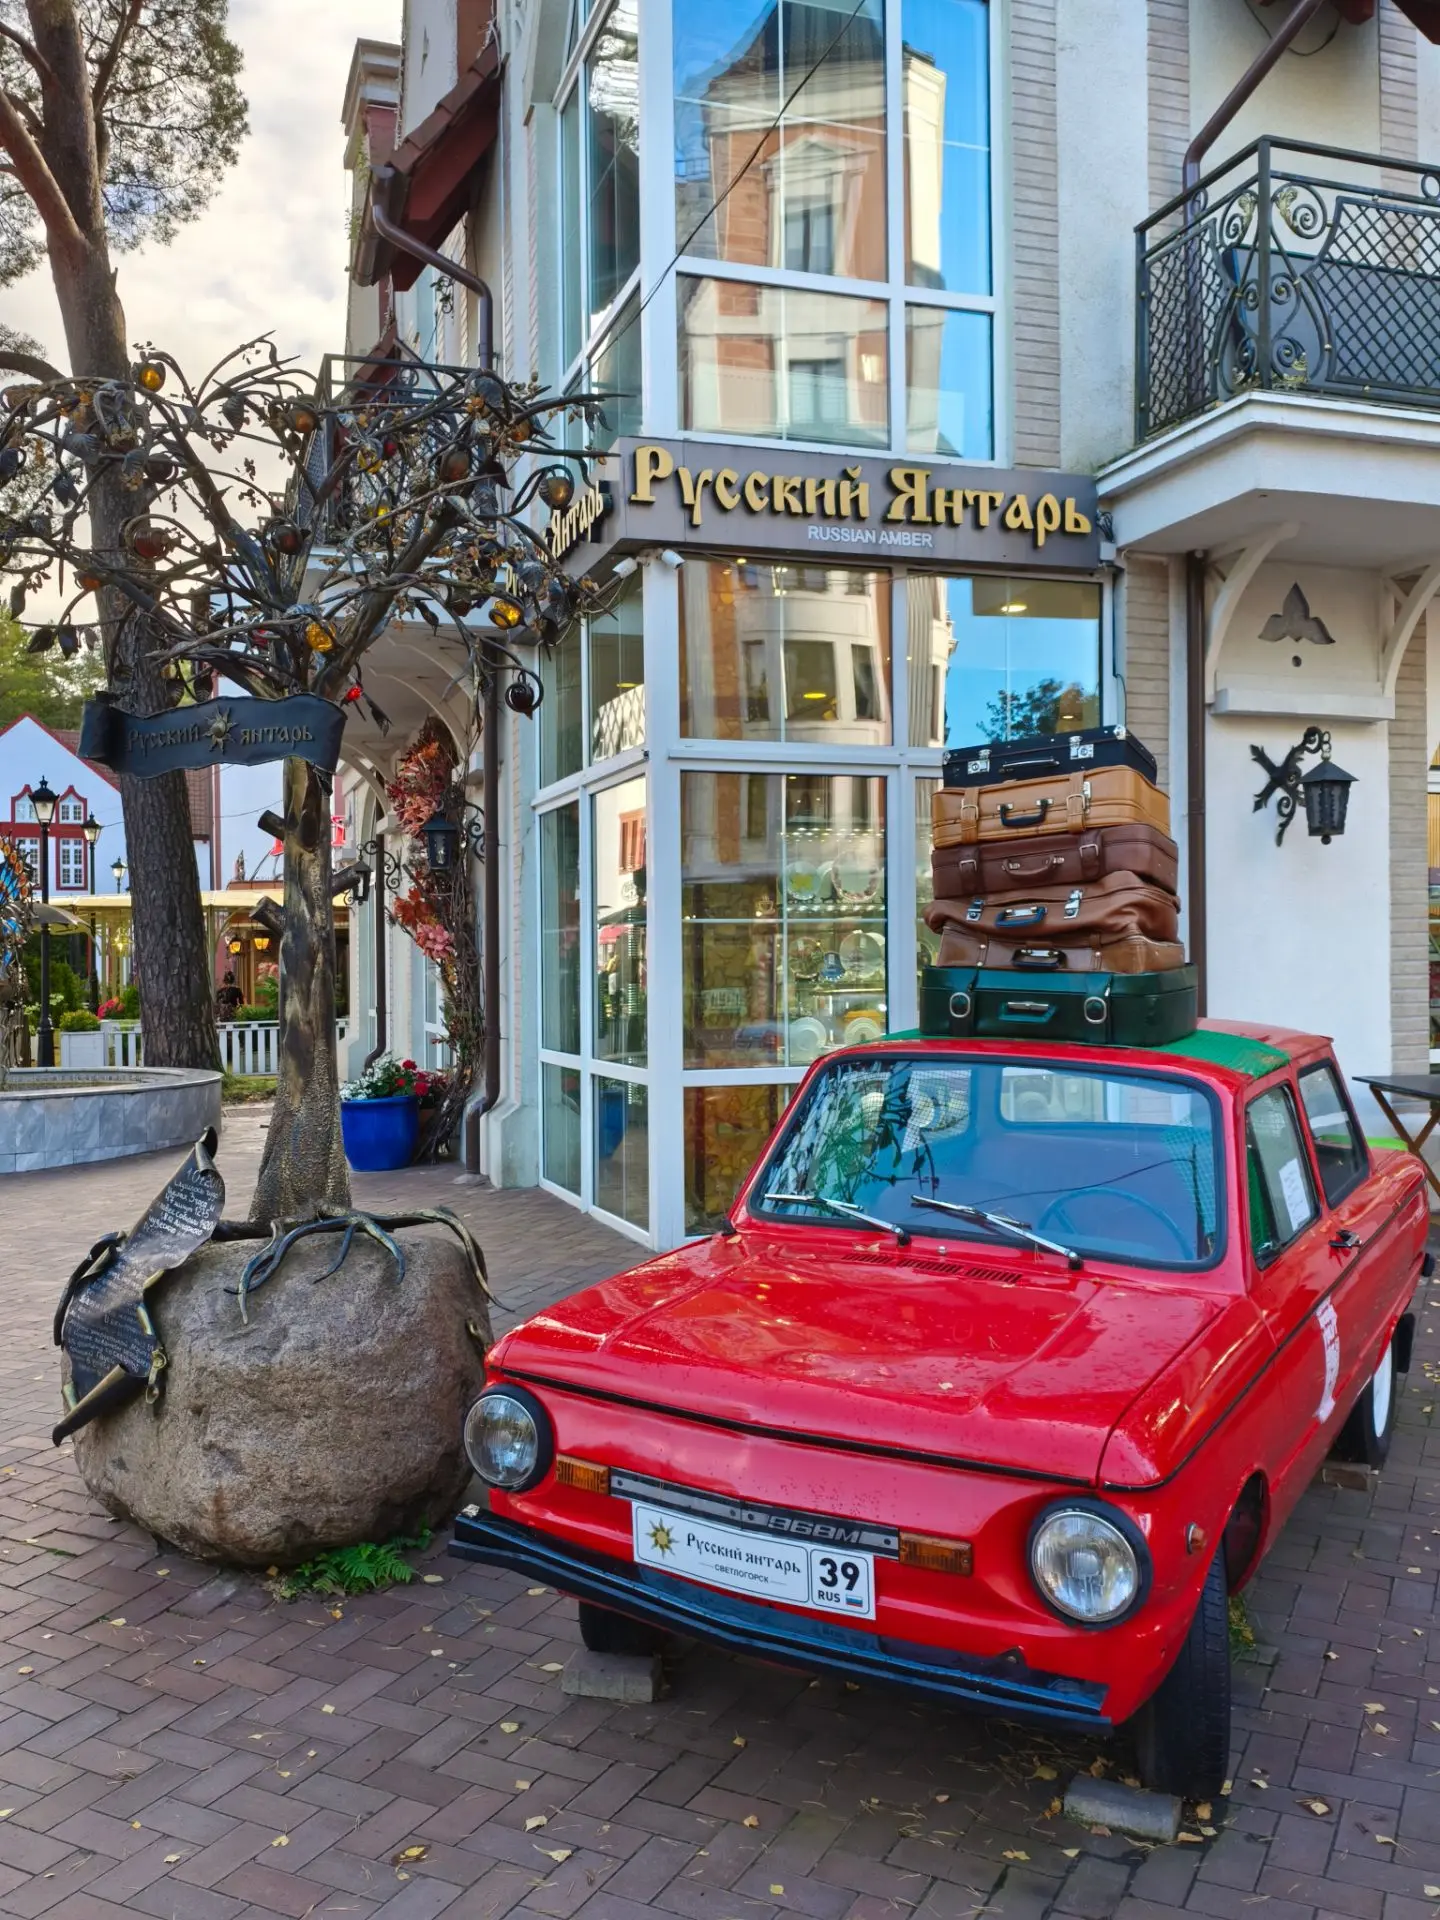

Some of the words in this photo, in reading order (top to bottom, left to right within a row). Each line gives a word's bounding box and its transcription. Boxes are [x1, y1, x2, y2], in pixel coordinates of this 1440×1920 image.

[630, 445, 871, 525] Русский
[886, 467, 1092, 547] Янтарь
[551, 480, 604, 560] Янтарь
[807, 524, 876, 546] RUSSIAN
[877, 529, 933, 548] AMBER
[128, 723, 200, 755] Русский
[240, 725, 314, 750] янтарь
[686, 1532, 742, 1562] Русский
[745, 1549, 801, 1575] янтарь
[714, 1563, 770, 1584] СВЕТЛОГОРСК
[819, 1557, 860, 1591] 39
[817, 1589, 841, 1604] RUS
